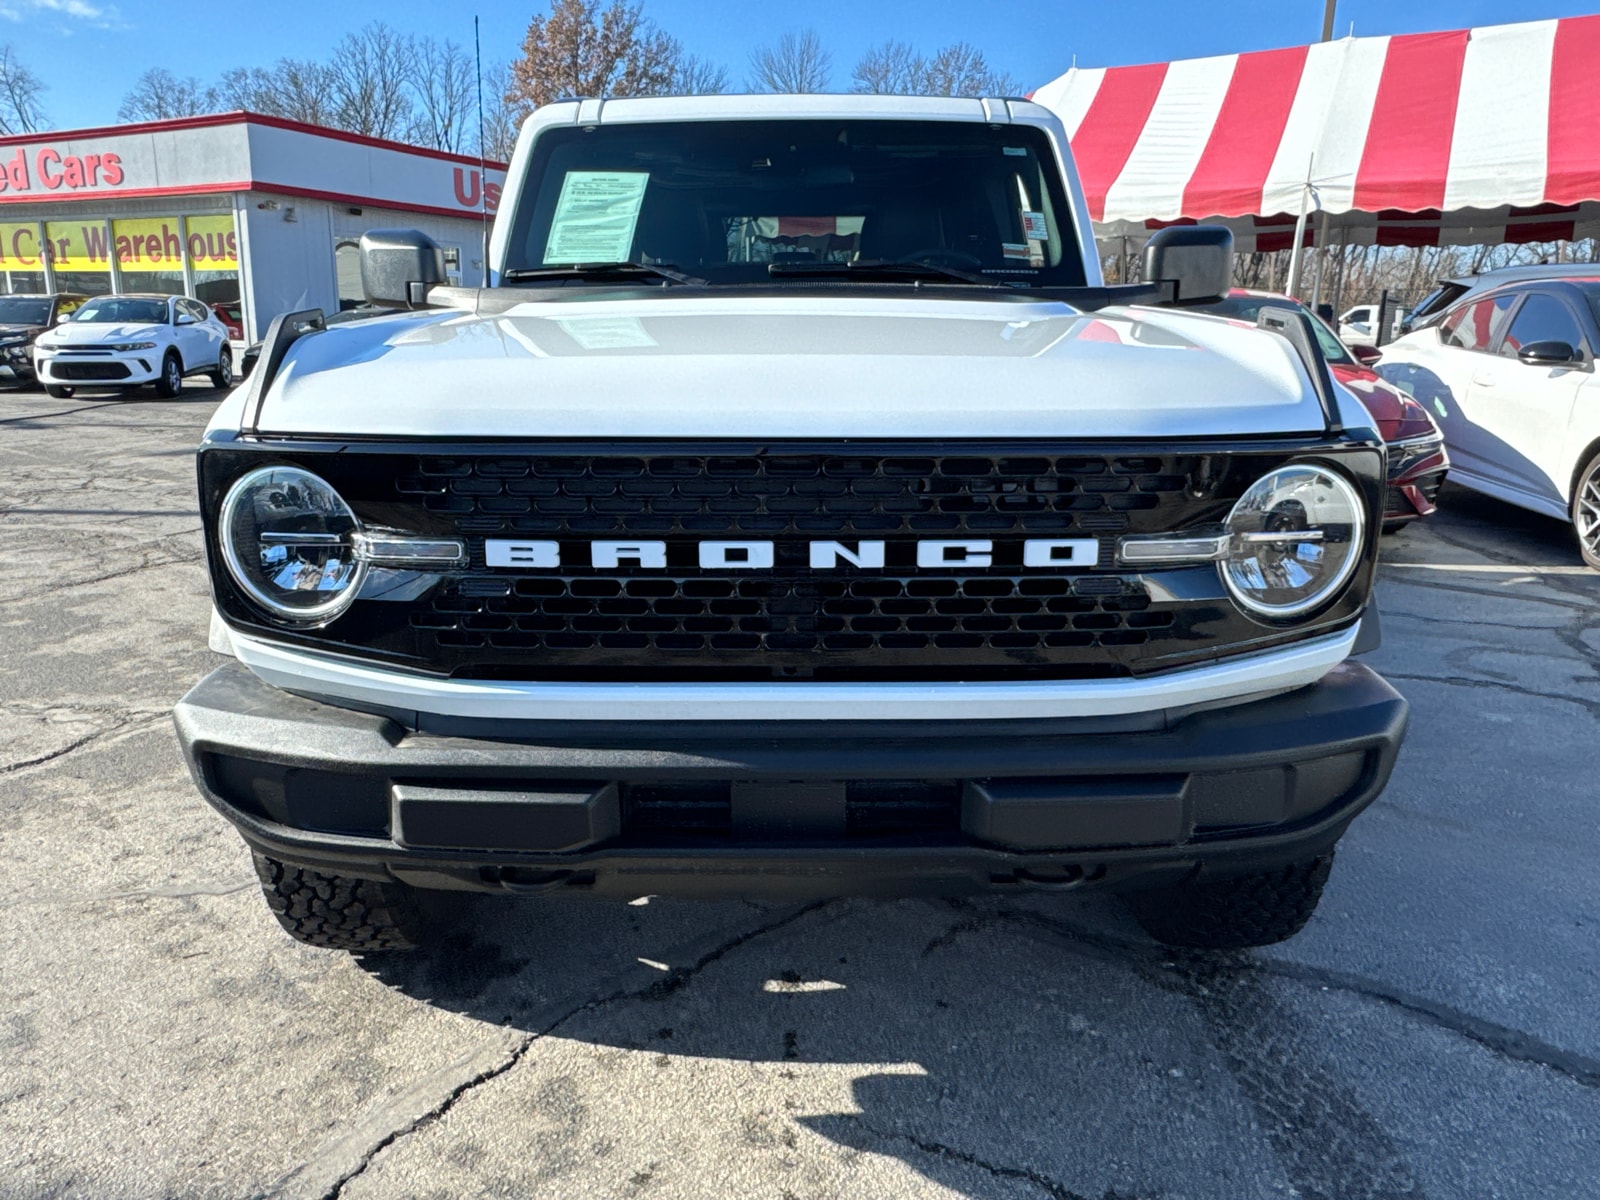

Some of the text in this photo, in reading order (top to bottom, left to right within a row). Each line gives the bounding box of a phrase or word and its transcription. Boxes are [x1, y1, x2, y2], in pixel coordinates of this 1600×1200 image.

[36, 147, 123, 189] Cars
[12, 228, 70, 265] Car
[485, 539, 1099, 568] BRONCO
